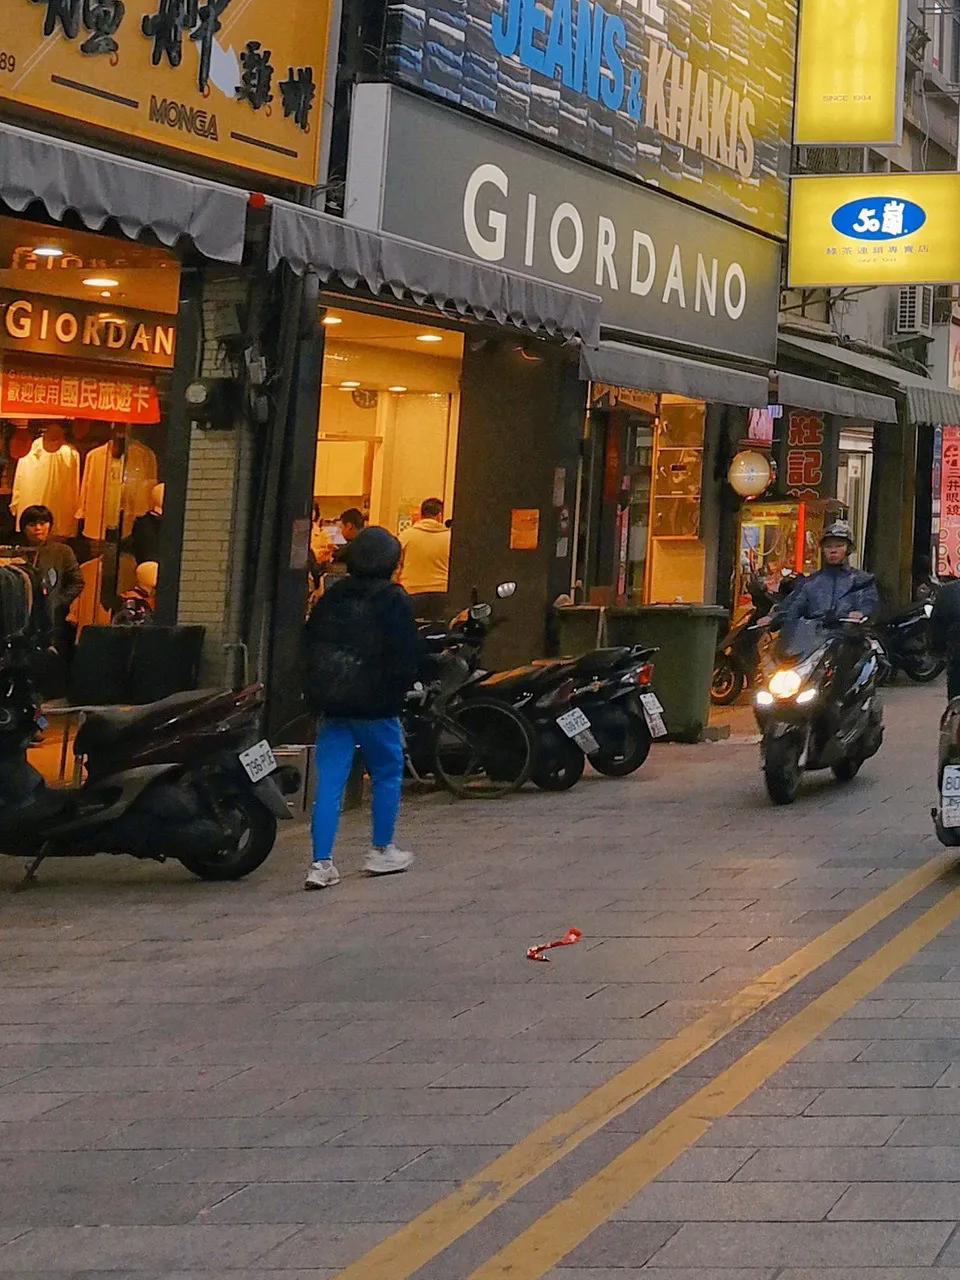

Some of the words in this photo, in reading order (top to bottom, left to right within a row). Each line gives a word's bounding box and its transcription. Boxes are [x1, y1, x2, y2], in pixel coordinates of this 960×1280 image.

[149, 94, 219, 142] MONGA
[627, 70, 644, 124] &
[645, 34, 755, 179] KHAKIS
[463, 162, 748, 320] GIORDANO
[852, 200, 905, 236] 50嵐
[7, 377, 150, 414] 歡迎使用國民旅遊卡
